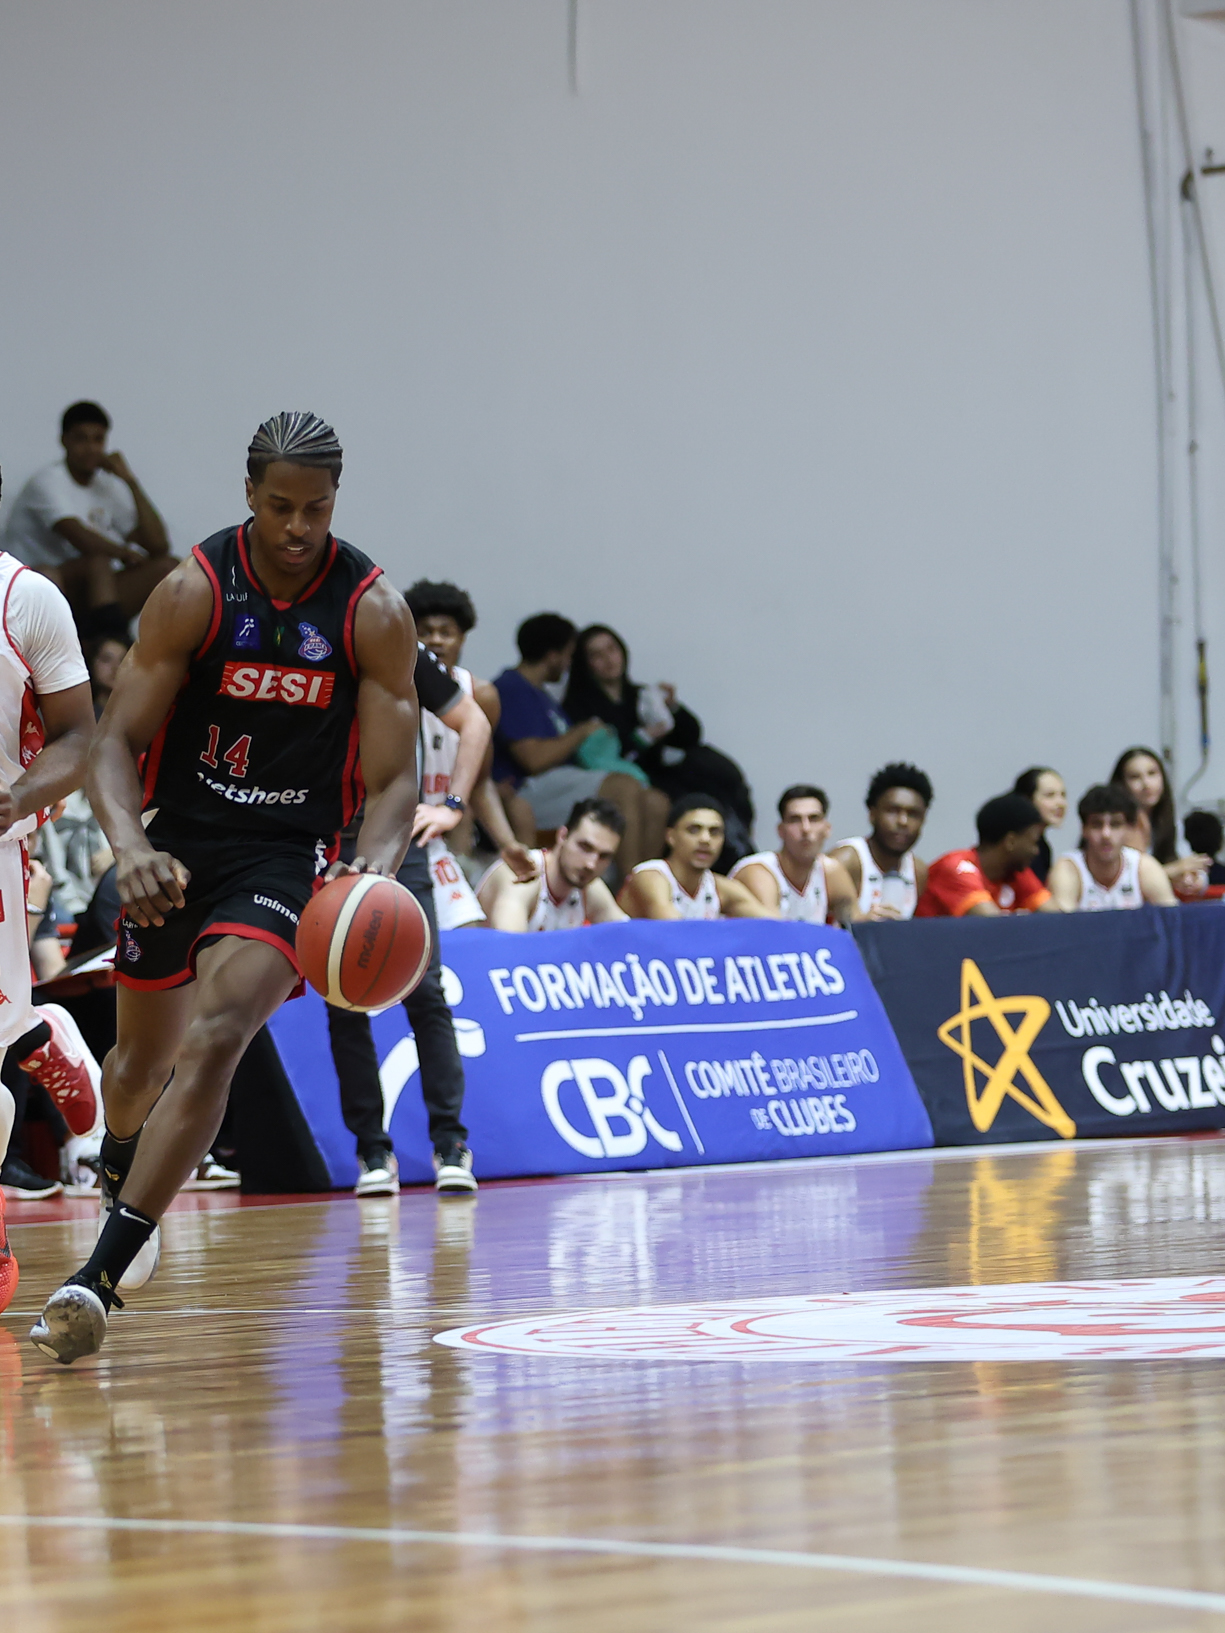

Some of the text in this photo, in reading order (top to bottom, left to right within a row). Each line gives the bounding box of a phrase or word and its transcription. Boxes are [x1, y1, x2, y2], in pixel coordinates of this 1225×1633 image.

[226, 667, 323, 703] SESI
[199, 724, 252, 778] 14
[488, 948, 846, 1021] FORMAÇÃO DE ATLETAS
[1054, 989, 1216, 1038] Universidade
[684, 1048, 880, 1099] COMITÊ BRASILEIRO
[540, 1054, 684, 1158] CBC
[750, 1095, 857, 1137] DE CLUBES
